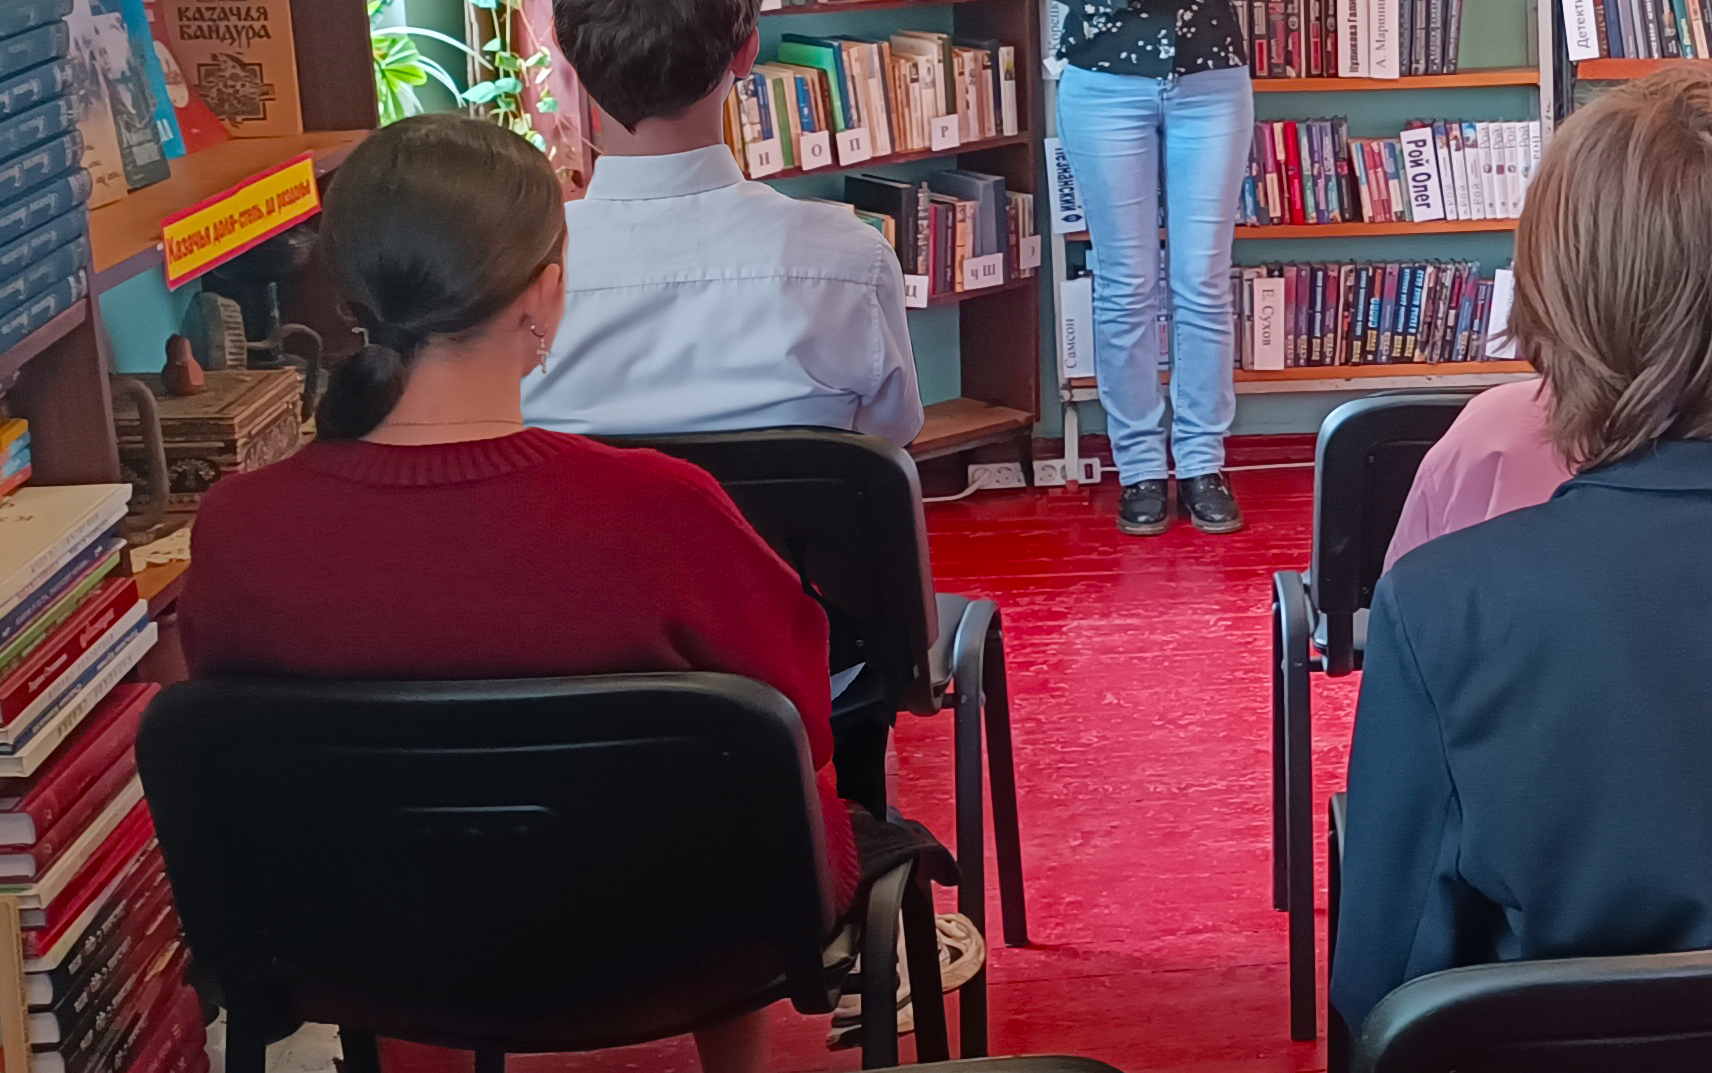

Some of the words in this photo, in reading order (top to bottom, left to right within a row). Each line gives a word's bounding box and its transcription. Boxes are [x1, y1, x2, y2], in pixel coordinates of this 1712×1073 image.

[179, 24, 272, 49] БАНДУРА
[1050, 1, 1062, 52] Корецк
[1406, 138, 1430, 169] Рой
[1411, 172, 1432, 209] Олег
[166, 226, 212, 265] Казачья
[1064, 317, 1077, 369] Самсон
[1258, 304, 1274, 346] Сухов
